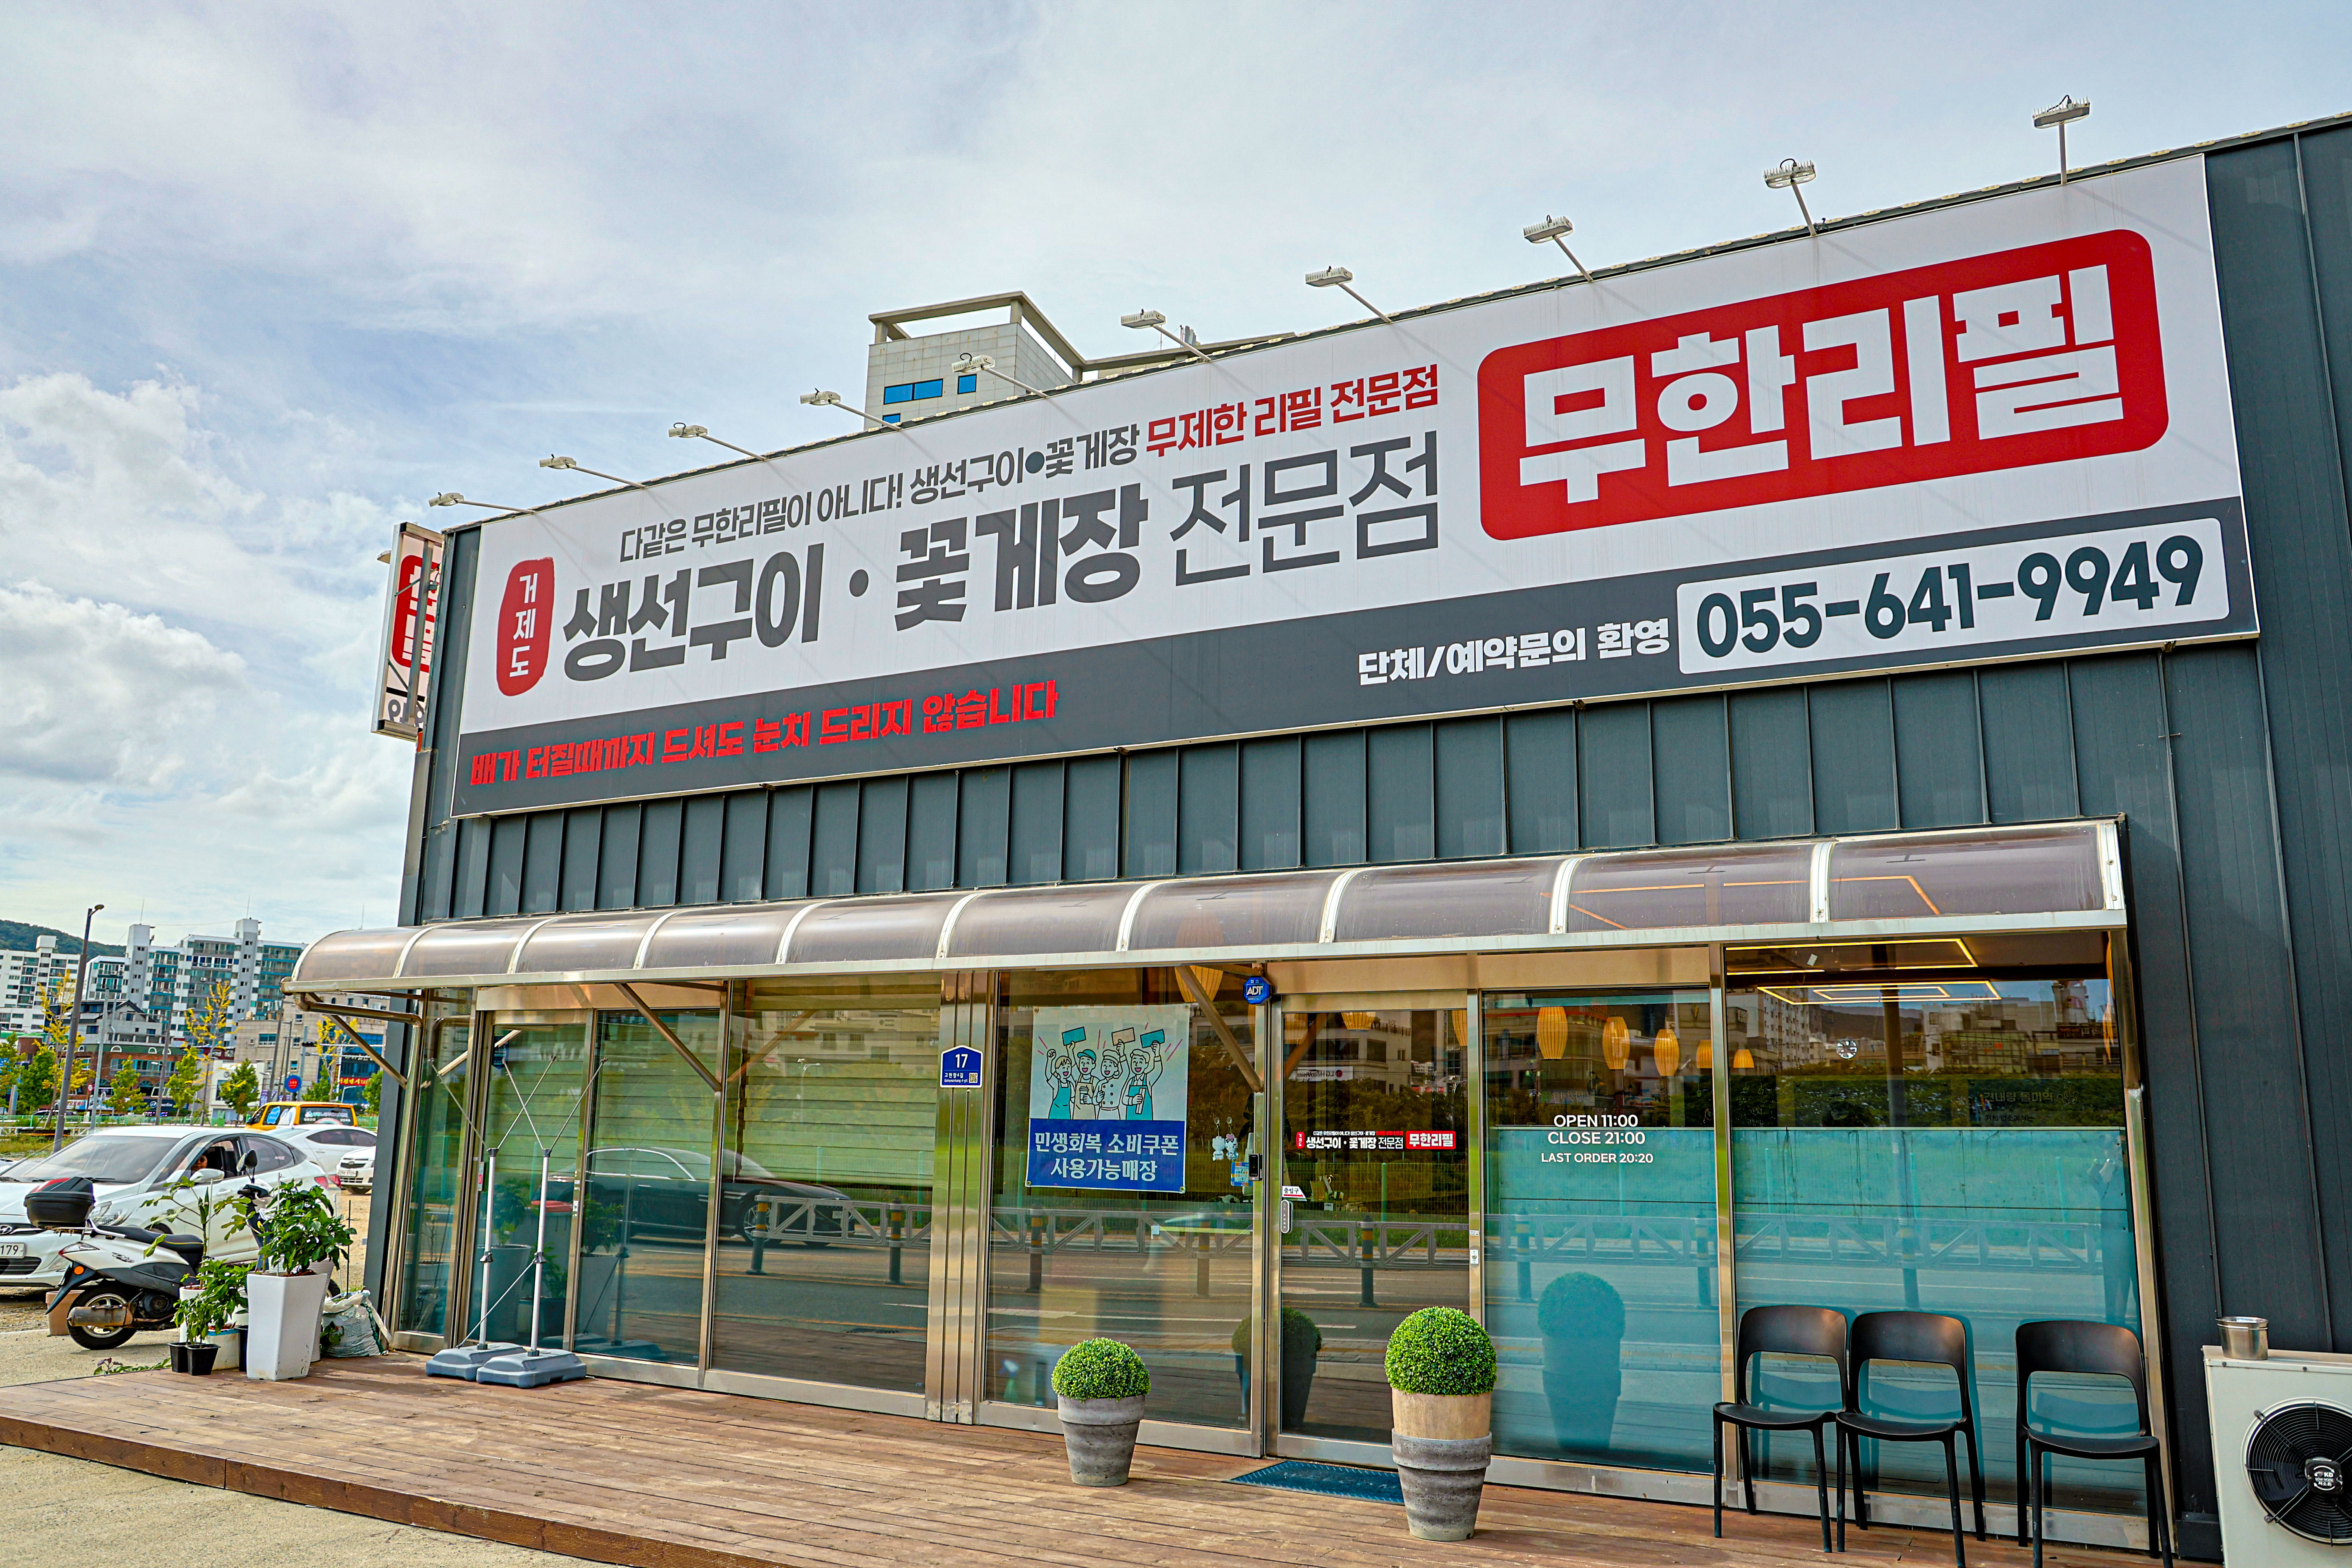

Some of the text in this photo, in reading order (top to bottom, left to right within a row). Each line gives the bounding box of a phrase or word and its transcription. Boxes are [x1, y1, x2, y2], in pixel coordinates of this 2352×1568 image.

[1520, 265, 2123, 503] 무한리필
[620, 519, 687, 562] 다같은
[692, 492, 812, 547] 무한리필이
[817, 472, 902, 521] 아니다!
[1147, 402, 1247, 457] 무제한
[1254, 387, 1321, 435] 리필
[1330, 364, 1438, 423] 전문점
[563, 543, 824, 681] 생선구이
[895, 483, 1148, 631] 꽃게장
[1170, 430, 1438, 586] 전문점
[1697, 535, 2203, 658] 055-641-9949
[509, 573, 538, 677] 거제도
[1359, 618, 1670, 686] 단체/예약문의 환영
[470, 680, 1059, 785] 배가 터질때까지 드셔도 눈치 드리지 않습니다
[1247, 986, 1263, 995] ADT
[955, 1054, 968, 1068] 17
[1554, 1114, 1638, 1127] OPEN 11:00
[1035, 1132, 1179, 1156] 민생회복 소비쿠폰
[1306, 1137, 1341, 1149] 생선구이
[1349, 1137, 1377, 1149] 꽃게장
[1378, 1137, 1403, 1149] 전문점
[1409, 1133, 1453, 1147] 무한리필
[1548, 1132, 1645, 1144] CLOSE 21:00
[1051, 1158, 1158, 1181] 사용가능매장
[1541, 1153, 1653, 1163] LAST ORDER 20:20
